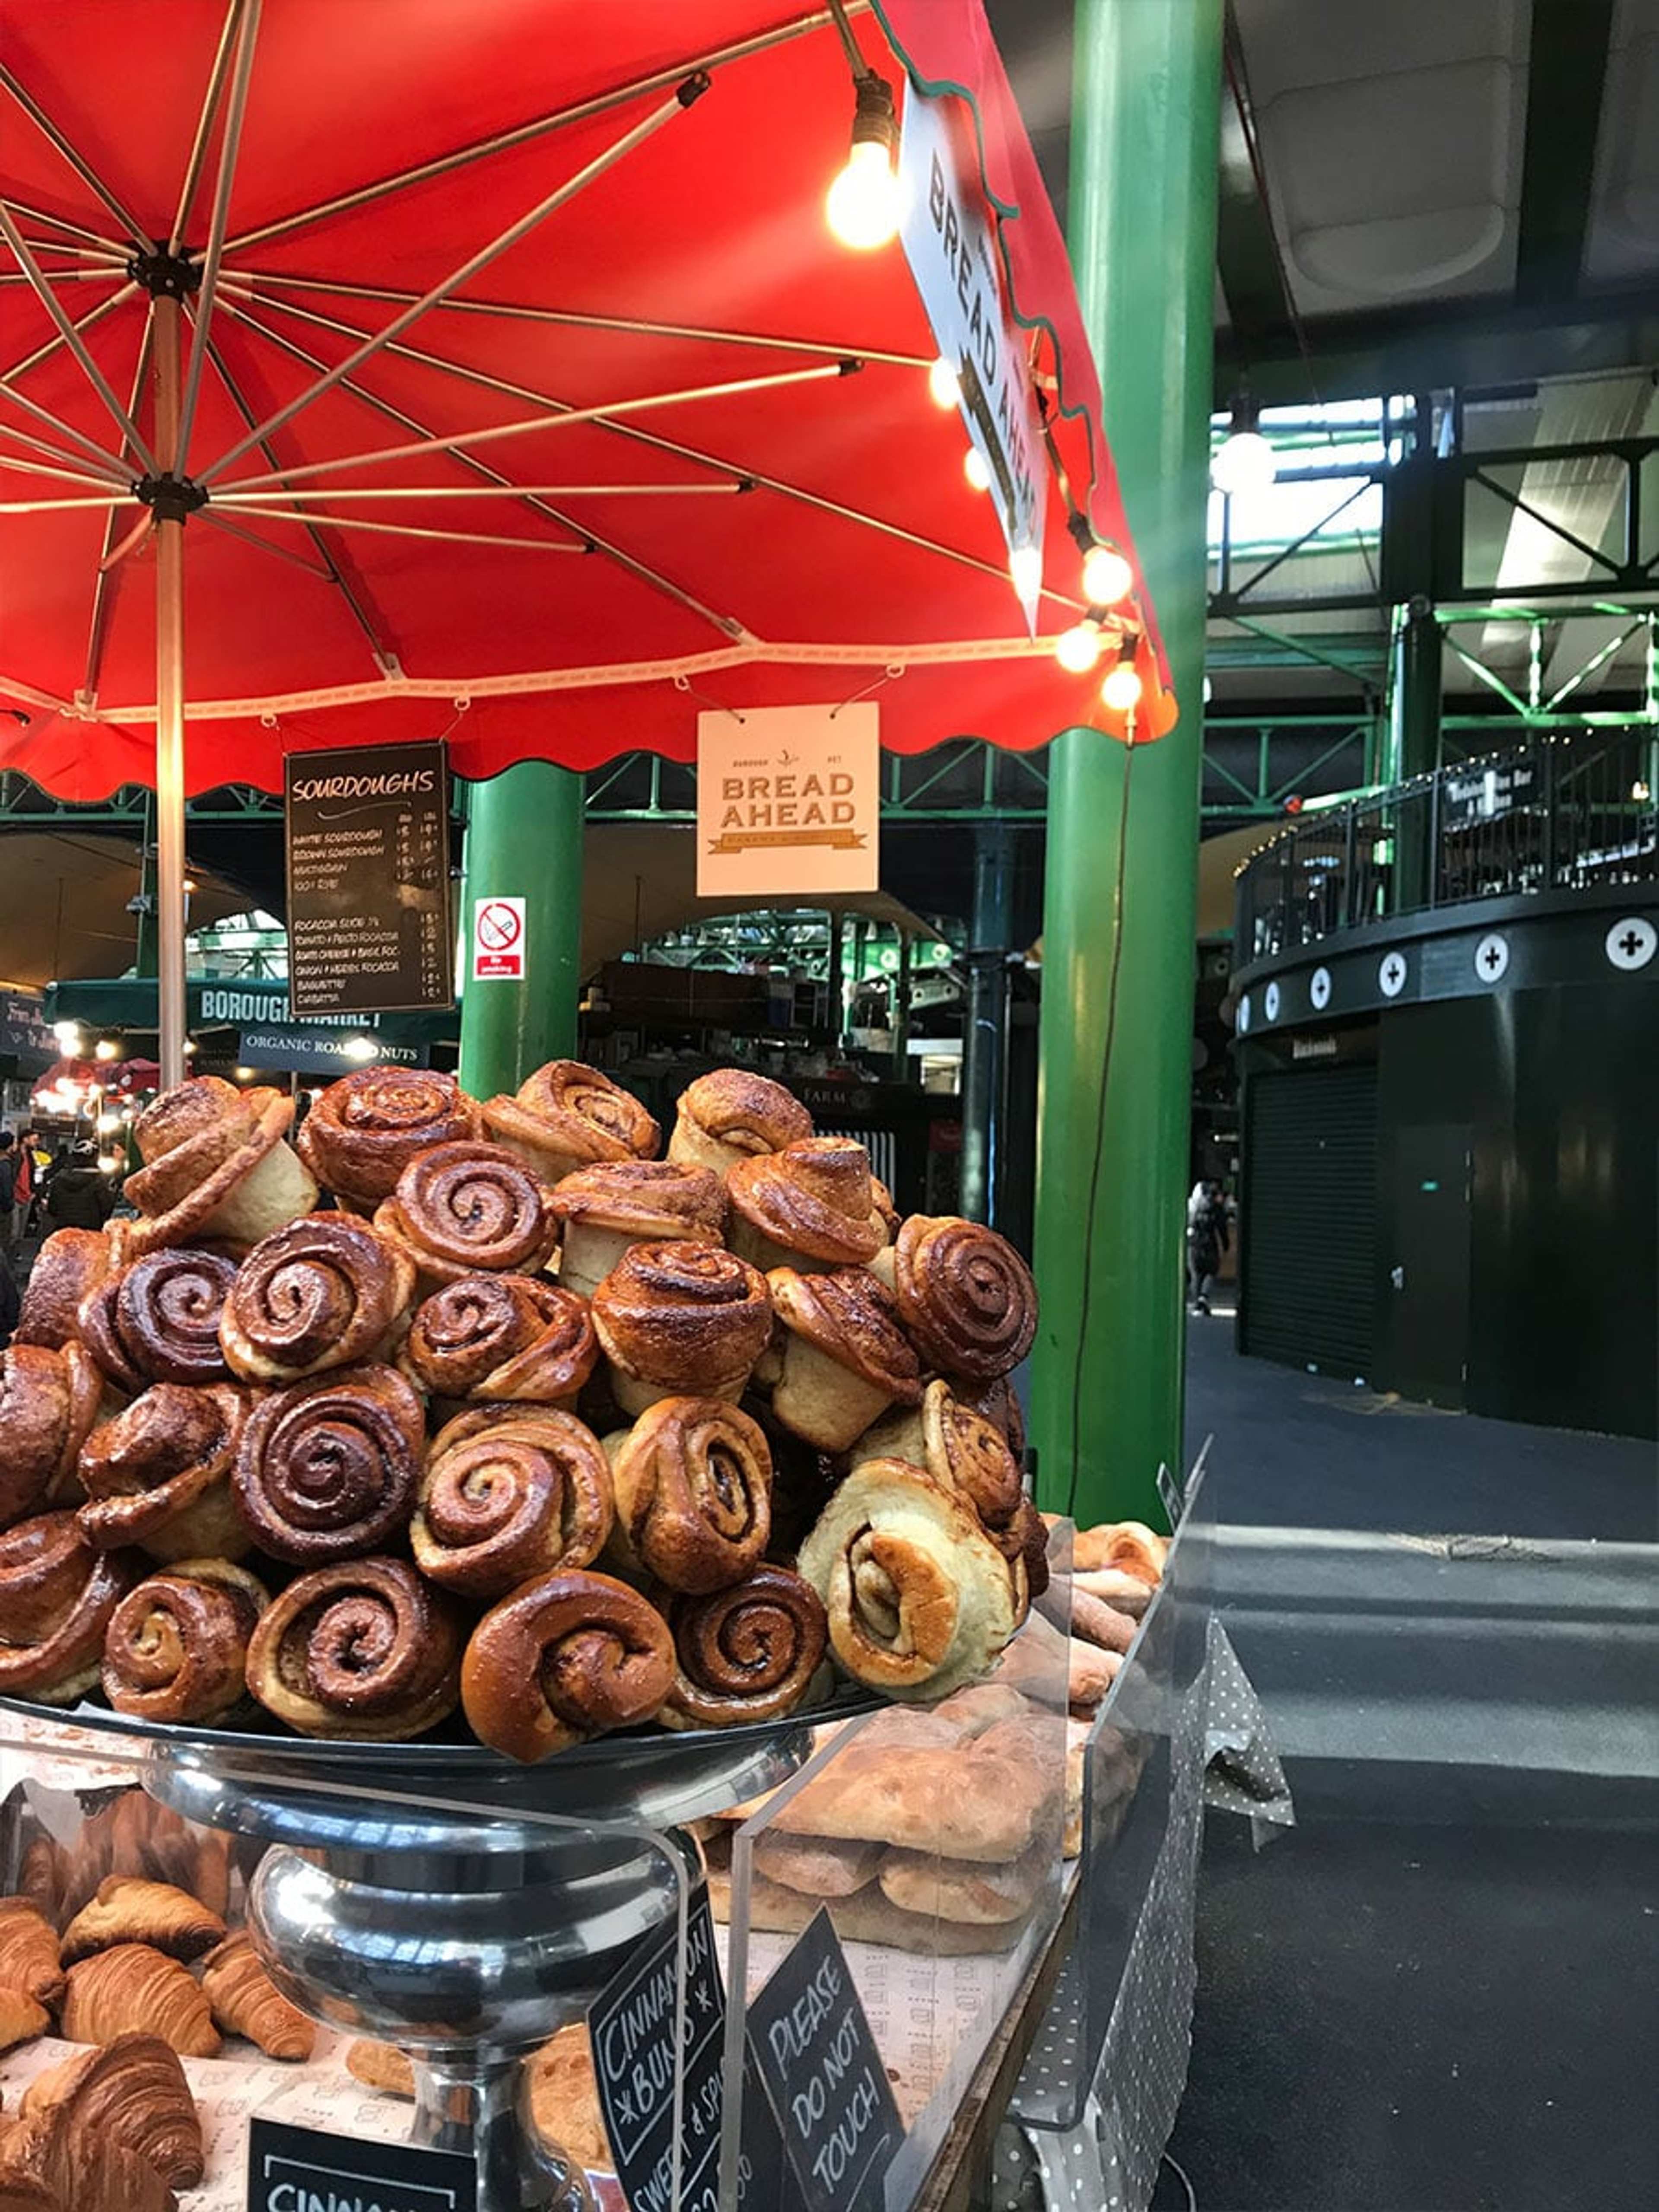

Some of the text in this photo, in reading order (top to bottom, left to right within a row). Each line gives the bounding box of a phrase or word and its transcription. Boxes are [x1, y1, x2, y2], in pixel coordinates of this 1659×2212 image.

[929, 148, 996, 386] BREAD
[292, 771, 434, 802] SOURDOUGHS
[720, 801, 855, 828] AHEAD
[722, 773, 855, 801] BREAD
[246, 1036, 312, 1051] ORGANIC
[380, 1046, 418, 1061] NUTS
[769, 1955, 841, 2081] PLEASE
[792, 2007, 860, 2139] DO NOT
[812, 2066, 880, 2194] TOUCH
